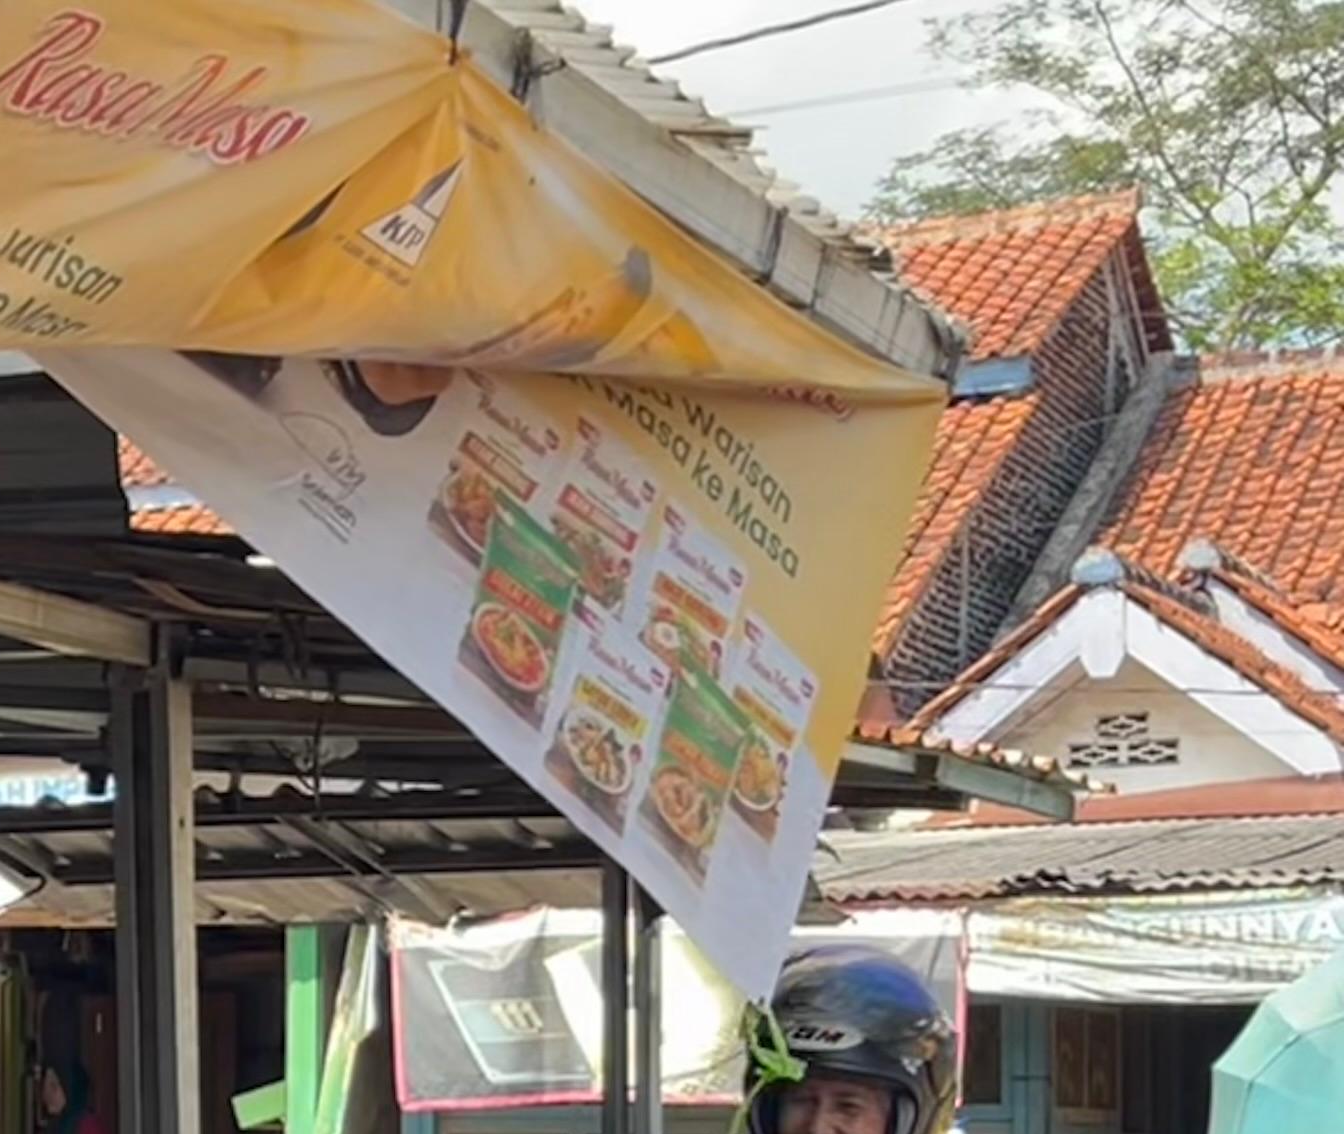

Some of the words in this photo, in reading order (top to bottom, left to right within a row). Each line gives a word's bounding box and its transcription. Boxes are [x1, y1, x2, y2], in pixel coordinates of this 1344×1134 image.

[682, 397, 792, 523] Warisan
[691, 450, 724, 501] ke
[726, 488, 799, 579] Masa
